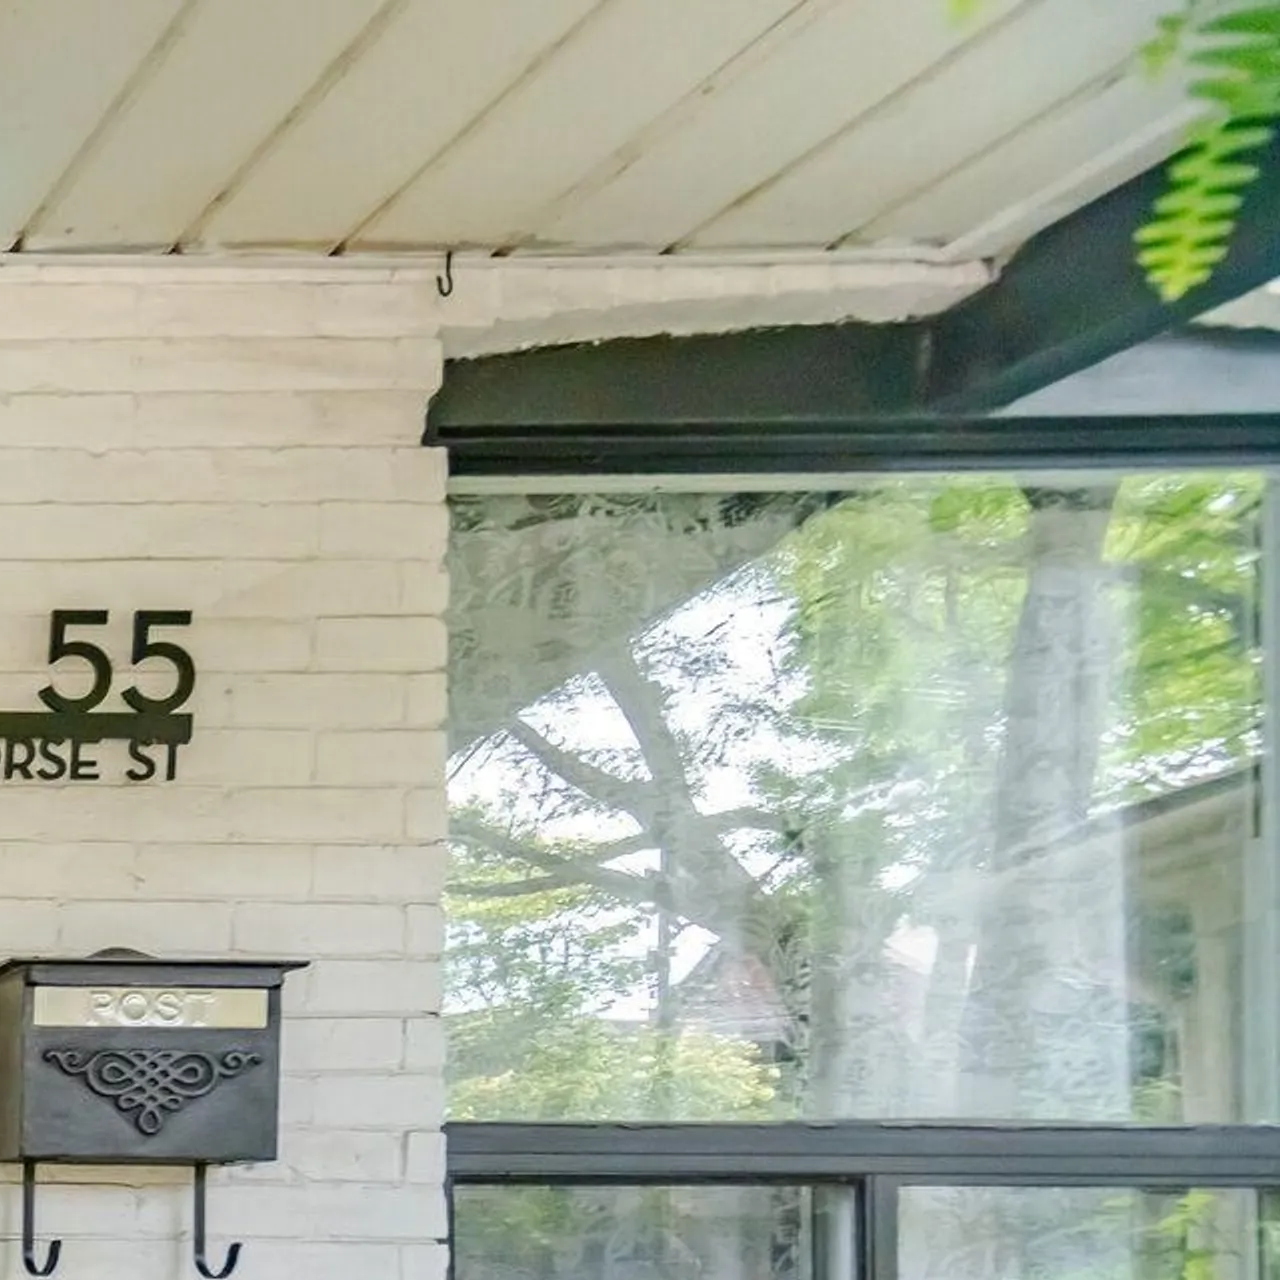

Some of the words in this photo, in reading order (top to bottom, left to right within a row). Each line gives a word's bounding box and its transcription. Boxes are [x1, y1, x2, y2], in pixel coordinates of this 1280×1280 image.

[37, 609, 196, 714] 55
[125, 736, 188, 781] ST
[87, 990, 216, 1027] POST
